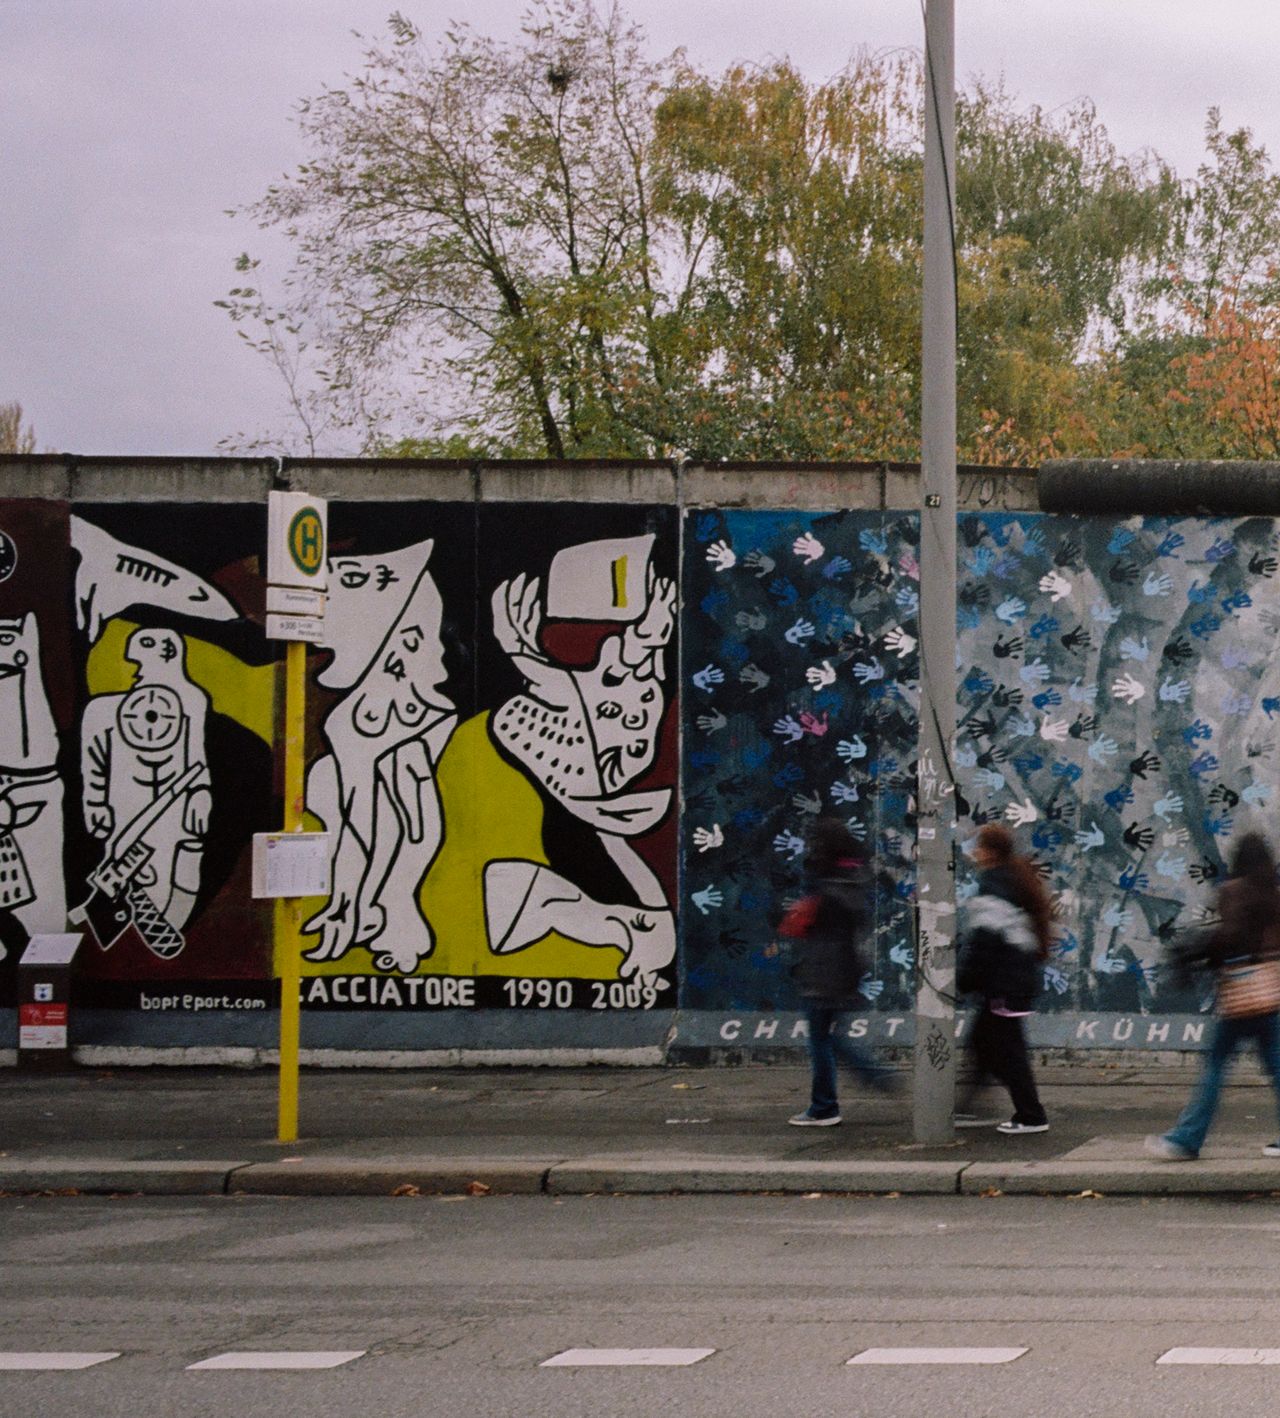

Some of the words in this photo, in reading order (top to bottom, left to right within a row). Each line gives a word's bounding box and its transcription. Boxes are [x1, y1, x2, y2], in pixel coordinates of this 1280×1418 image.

[929, 495, 940, 506] 21
[302, 523, 318, 560] H
[299, 977, 475, 1007] ACCIATORE
[503, 979, 573, 1009] 1990
[591, 983, 658, 1010] 2009
[1076, 1018, 1205, 1043] KÜHN
